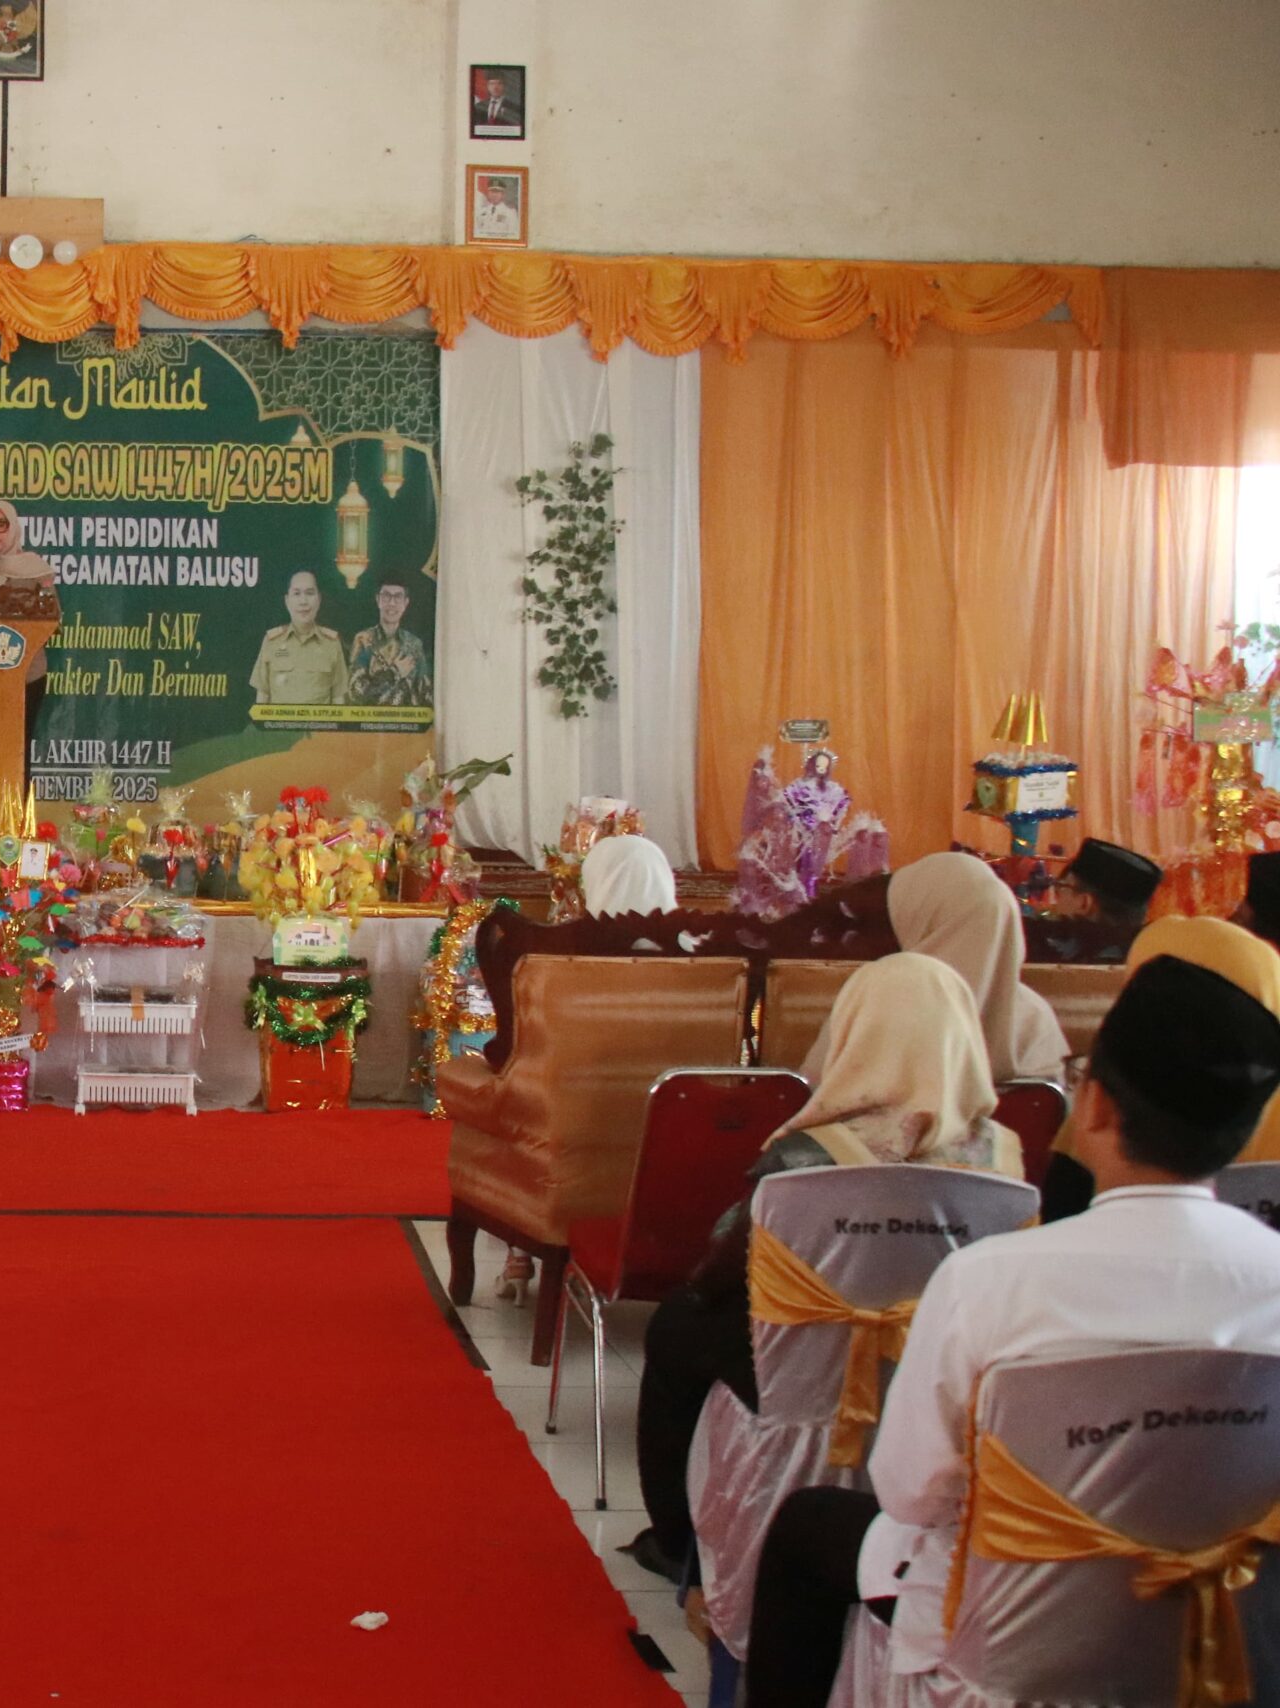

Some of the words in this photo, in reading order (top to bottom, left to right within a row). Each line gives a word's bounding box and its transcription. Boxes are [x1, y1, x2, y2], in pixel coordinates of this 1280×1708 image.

[63, 356, 208, 420] Maulid
[52, 442, 120, 499] SAW
[125, 442, 332, 511] 1447H/2025M
[17, 516, 74, 547] TUAN
[81, 517, 218, 549] PENDIDIKAN
[177, 556, 259, 587] BALUSU
[158, 612, 202, 659] SAW,
[106, 658, 145, 697] Dan
[150, 658, 228, 697] Beriman
[45, 739, 108, 765] AKHIR
[111, 740, 153, 766] 1447
[158, 740, 172, 766] H
[113, 776, 158, 802] 2025
[835, 1218, 882, 1235] Kare
[1143, 1404, 1269, 1432] Dekorasi
